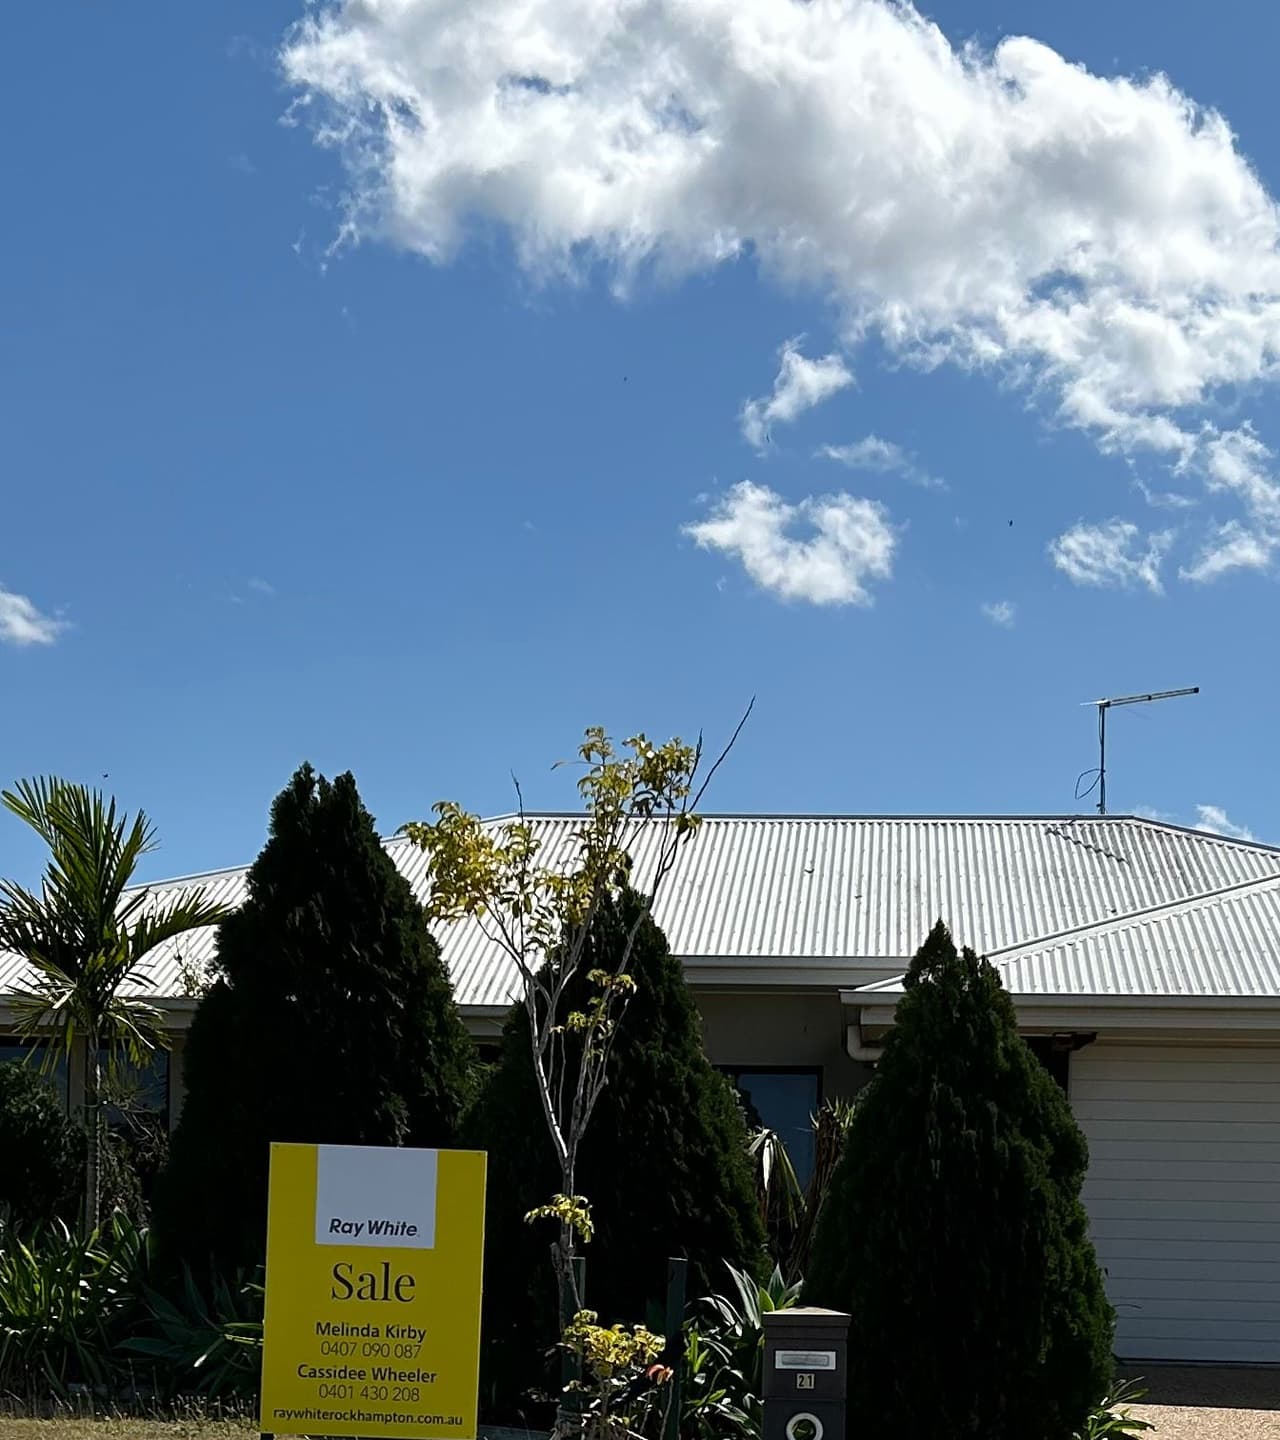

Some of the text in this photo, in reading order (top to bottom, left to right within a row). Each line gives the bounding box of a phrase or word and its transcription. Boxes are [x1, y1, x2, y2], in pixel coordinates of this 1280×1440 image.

[329, 1218, 418, 1238] Ray White
[331, 1261, 416, 1302] Sale
[316, 1322, 427, 1343] Melinda Kirby
[320, 1341, 421, 1359] 0407 090 087
[297, 1364, 437, 1383] Cassidee Wheeler
[798, 1375, 813, 1387] 21
[319, 1384, 420, 1402] 0401 430 208
[273, 1408, 463, 1426] raywhiterockhampton.com.au
